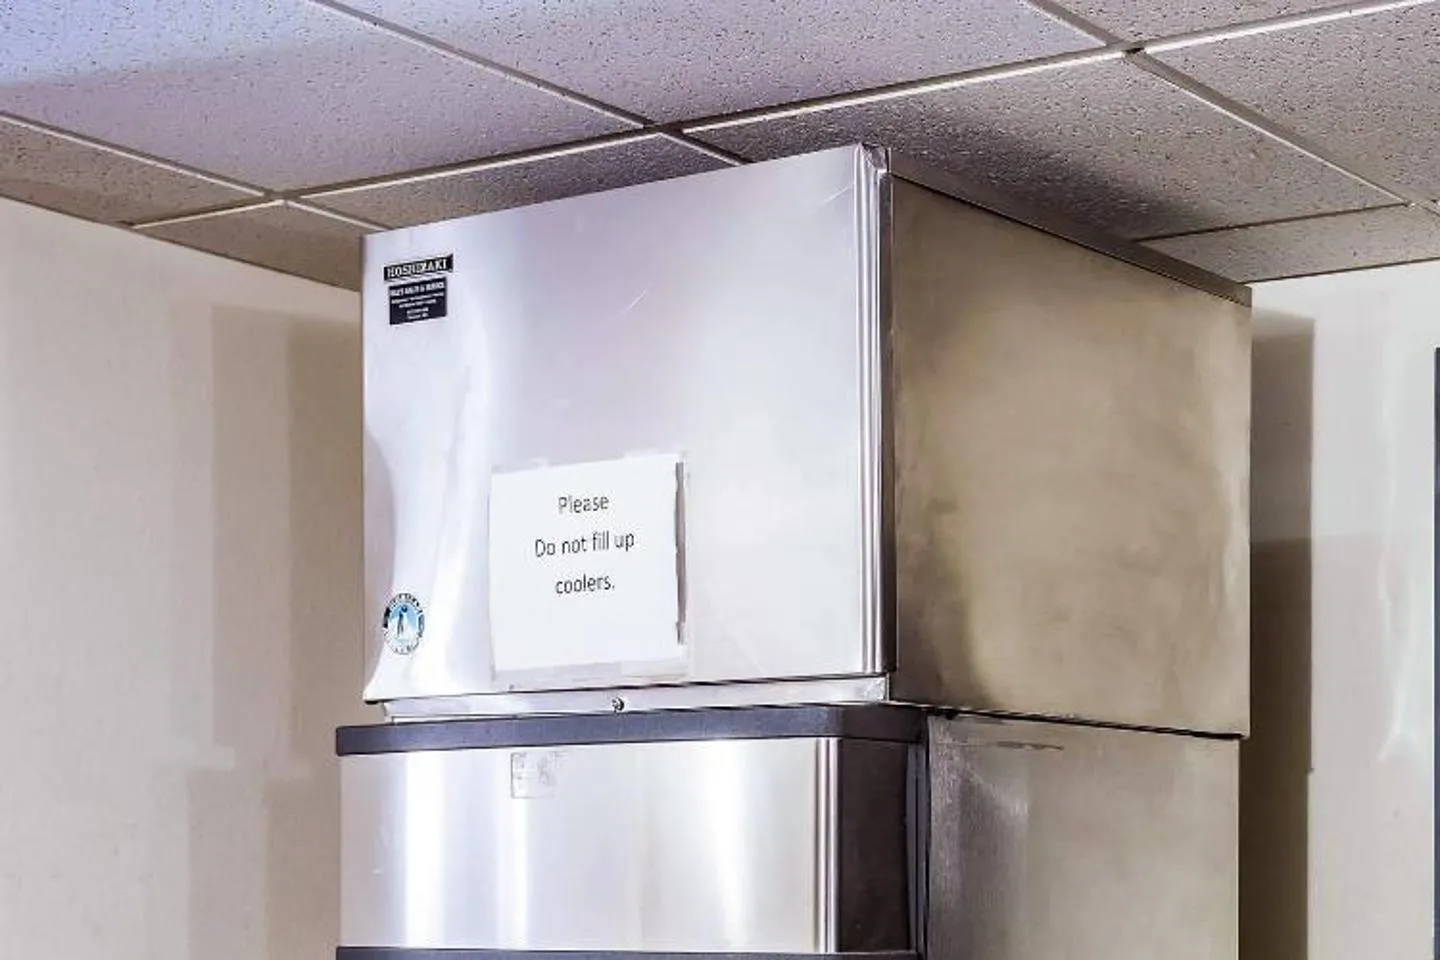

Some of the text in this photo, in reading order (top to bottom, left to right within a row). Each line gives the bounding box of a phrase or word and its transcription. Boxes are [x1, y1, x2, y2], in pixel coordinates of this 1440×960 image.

[558, 495, 609, 514] Please
[535, 530, 635, 558] Do not fill up
[555, 573, 616, 595] coolers.
